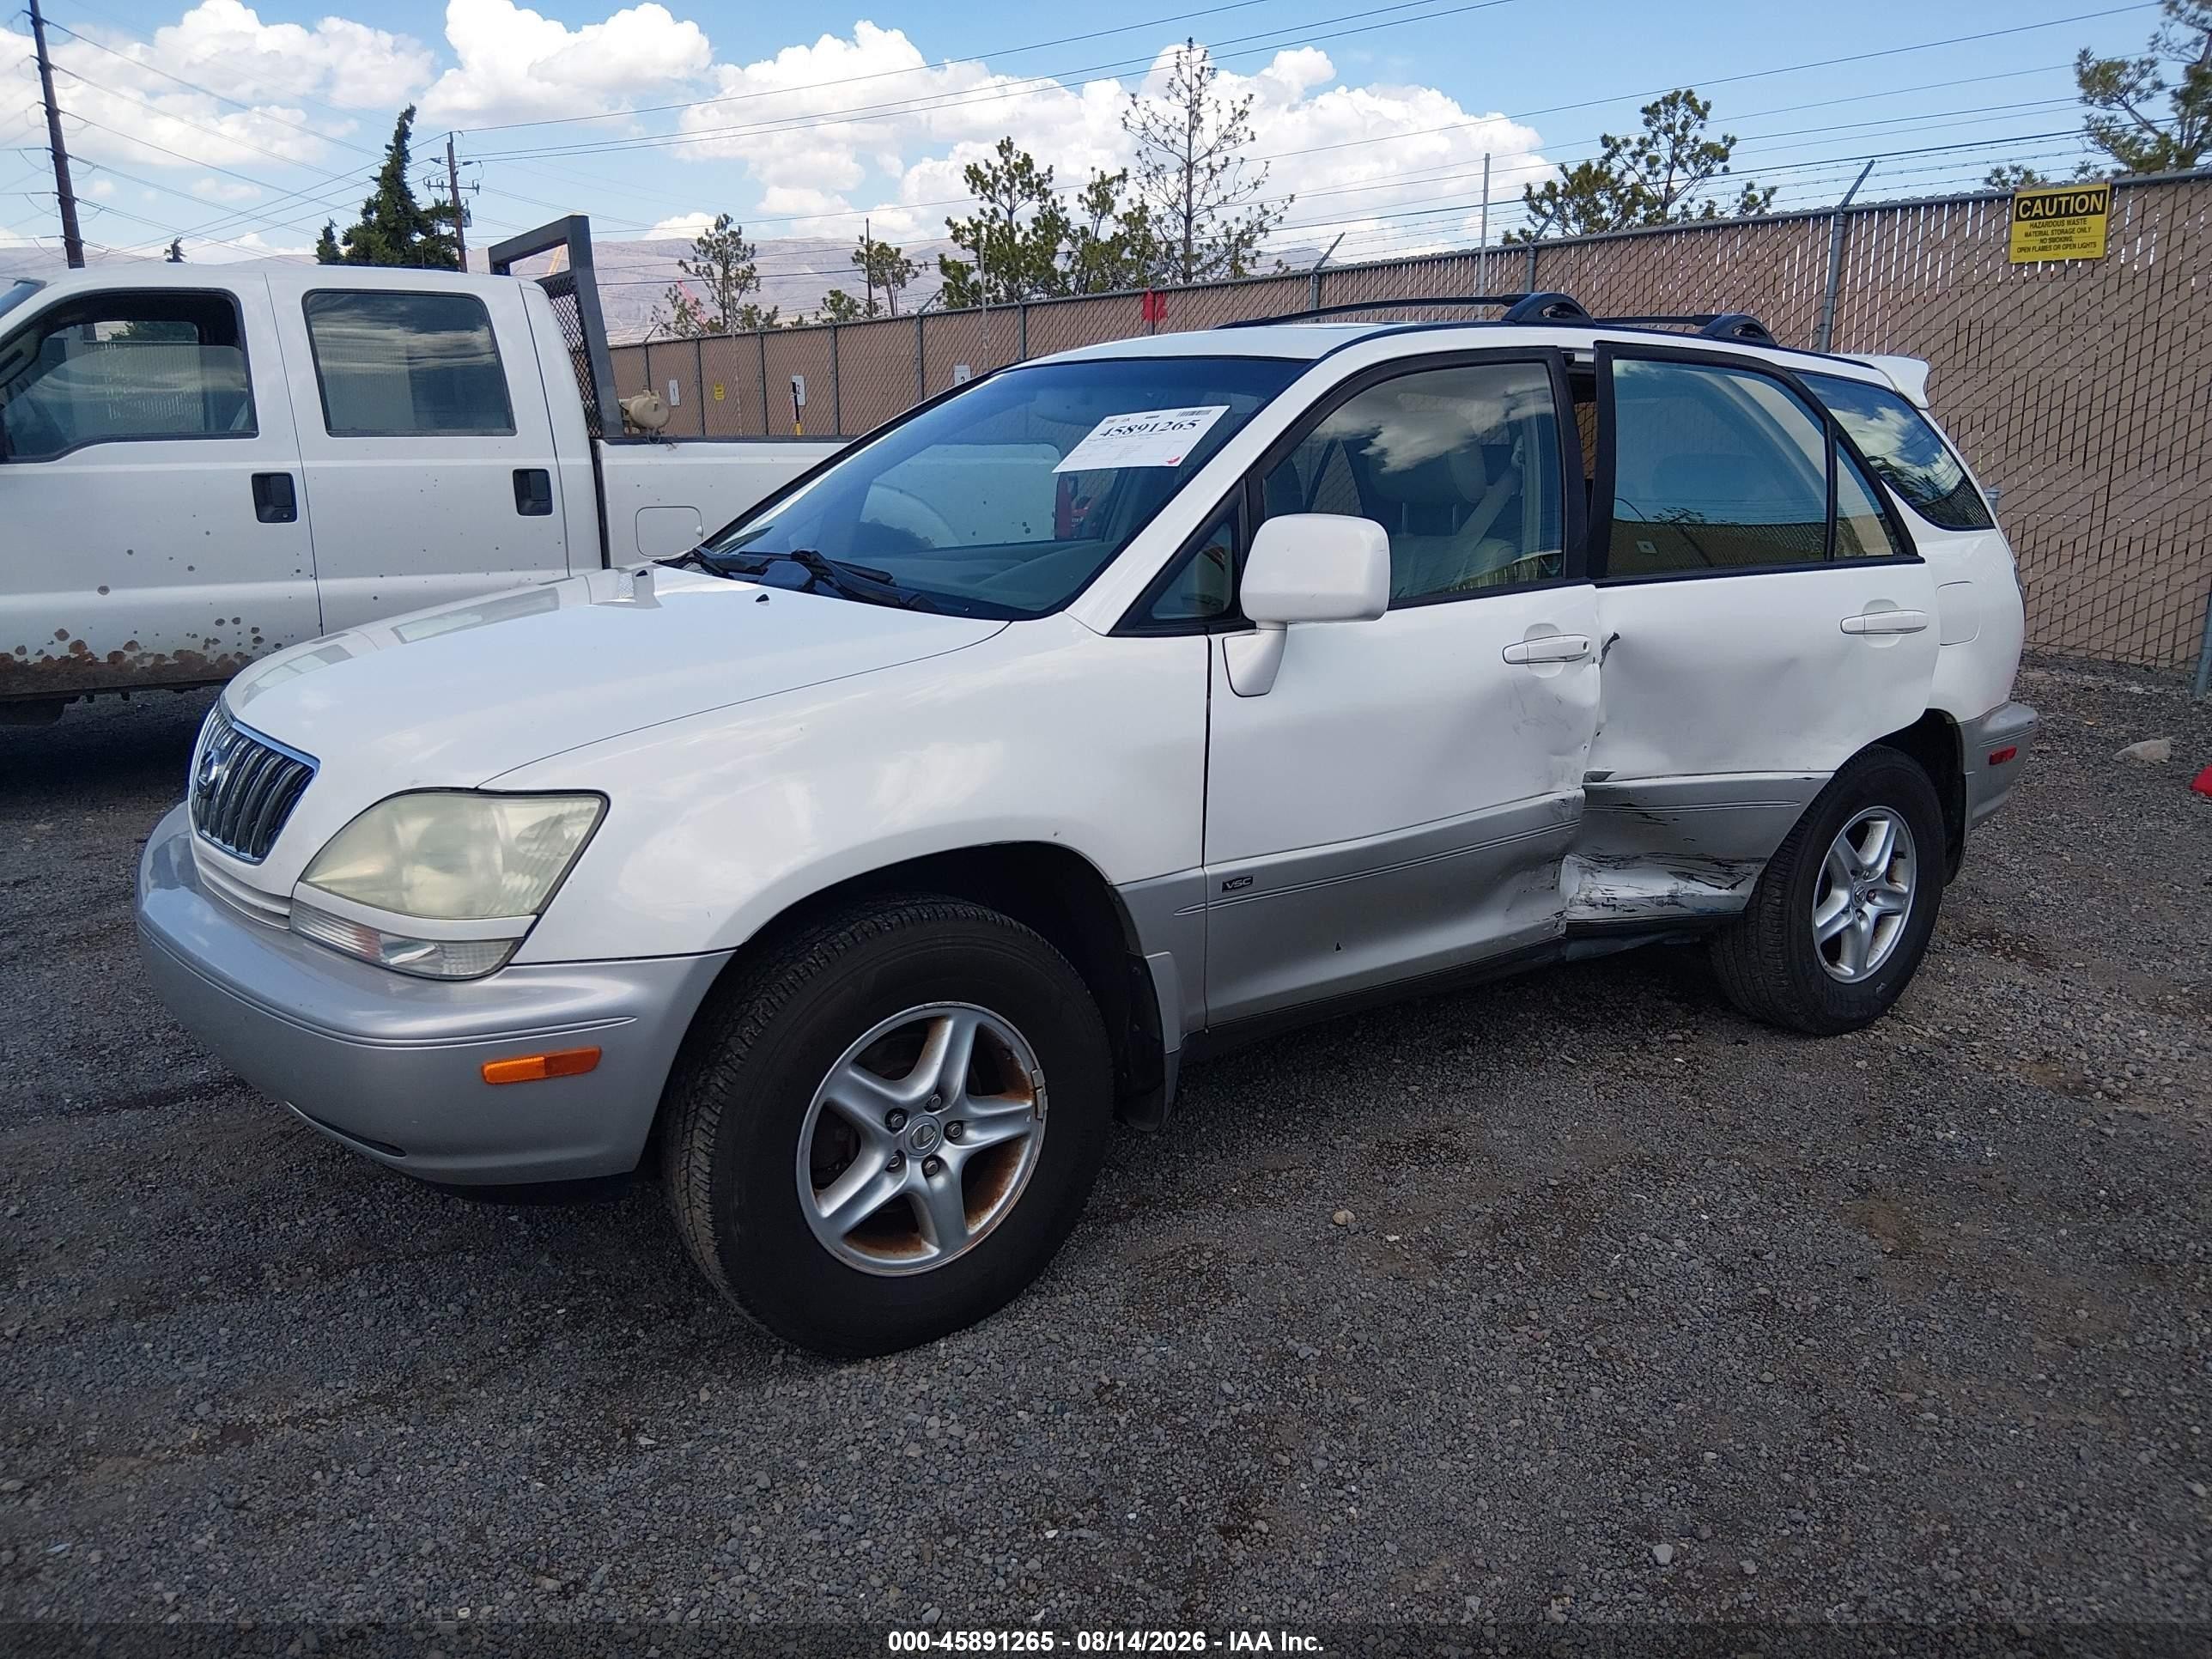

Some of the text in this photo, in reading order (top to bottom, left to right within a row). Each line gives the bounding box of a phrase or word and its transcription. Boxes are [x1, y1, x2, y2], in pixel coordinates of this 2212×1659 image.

[2019, 192, 2104, 219] CAUTION
[2029, 217, 2087, 228] HAZARDOUS WASTE
[2024, 229, 2050, 238] MATERIAL
[2051, 228, 2075, 236] STORAGE
[1099, 418, 1201, 438] 45891265
[1225, 877, 1252, 889] VSC
